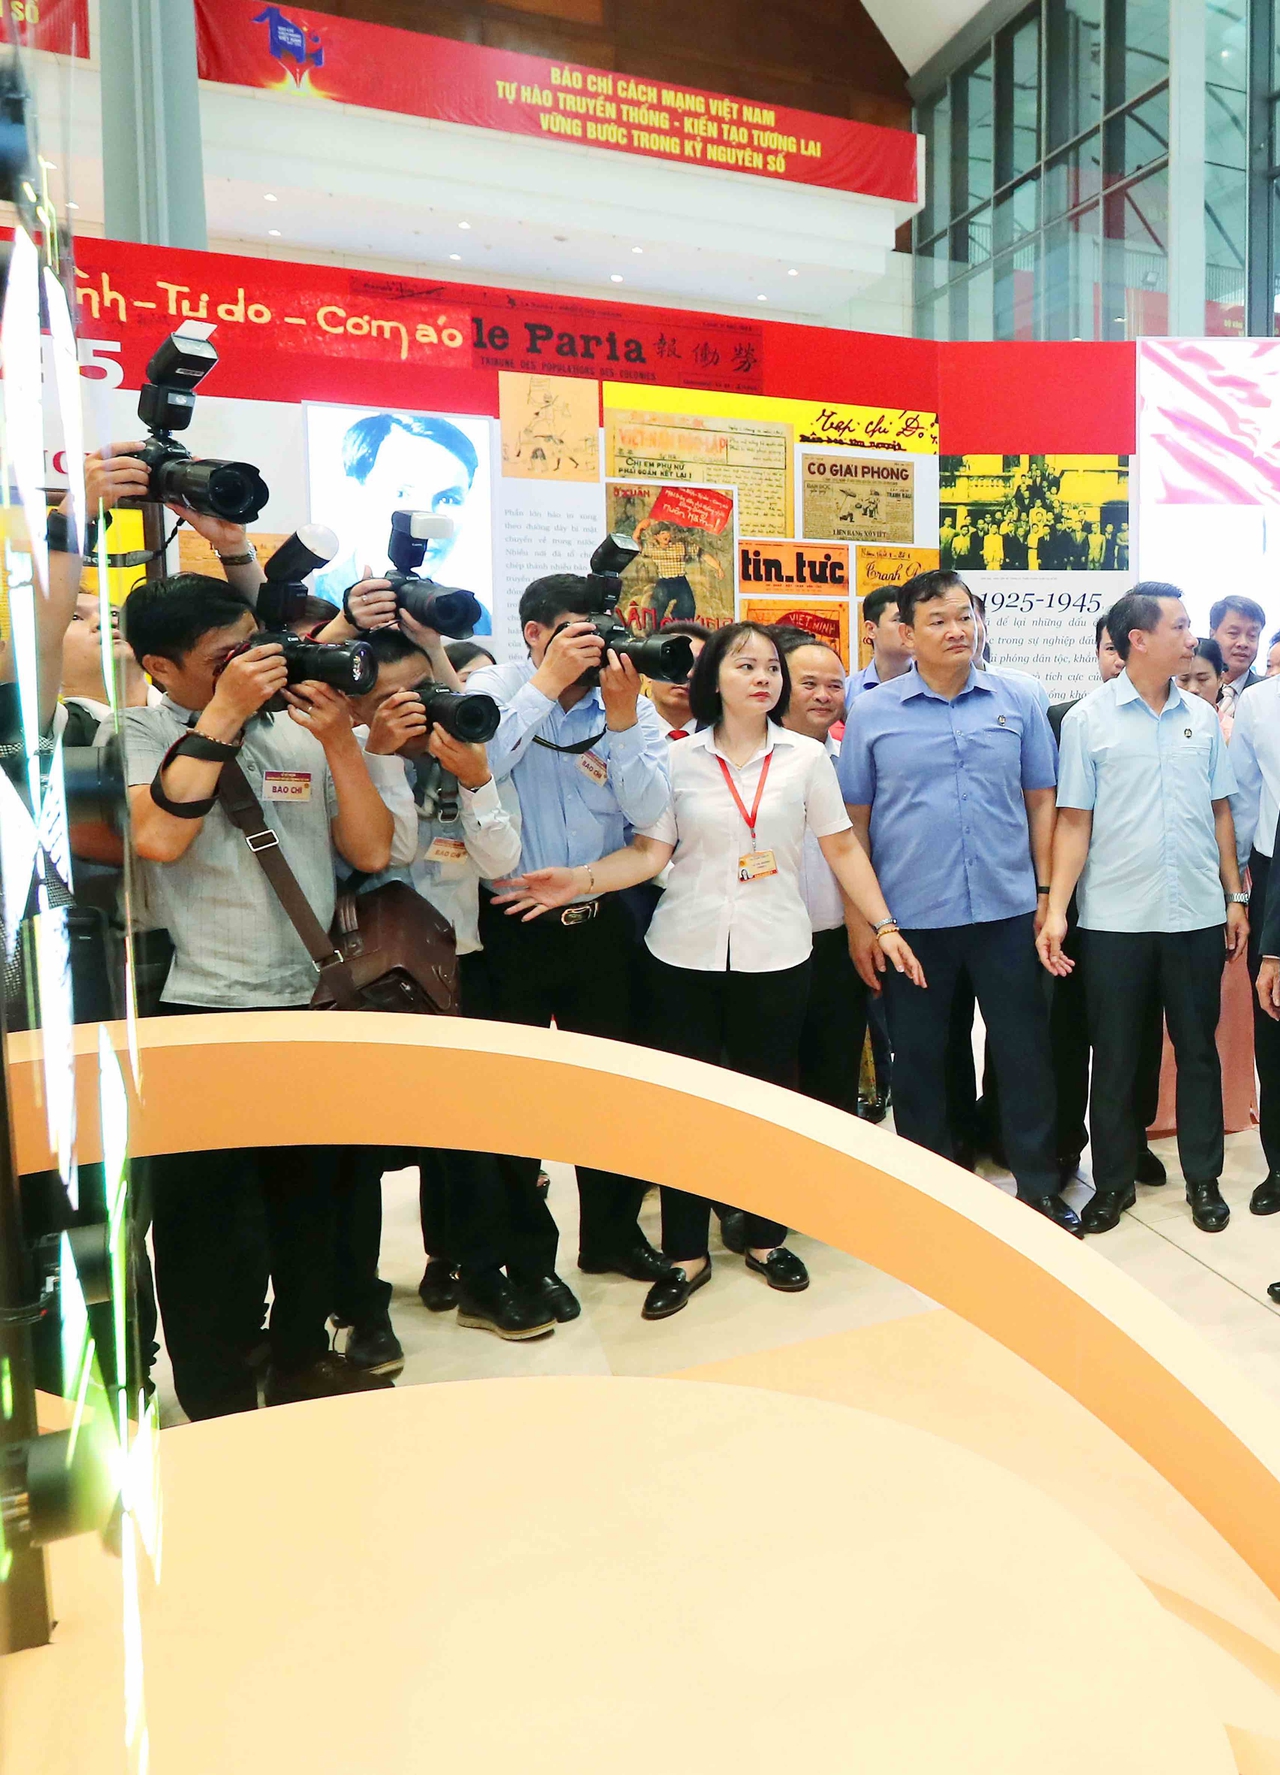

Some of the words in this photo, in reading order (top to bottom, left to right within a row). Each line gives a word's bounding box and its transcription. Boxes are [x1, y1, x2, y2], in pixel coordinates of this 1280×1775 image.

[551, 66, 583, 90] BÁO
[587, 74, 613, 95] CHÍ
[617, 79, 658, 104] CÁCH
[661, 88, 706, 113] MẠNG
[708, 98, 739, 121] VIỆT
[742, 105, 776, 127] NAM
[496, 80, 518, 104] TỰ
[520, 84, 553, 107] HÀO
[557, 92, 617, 119] TRUYỀN
[620, 103, 670, 130] THỐNG
[684, 115, 718, 139] KIẾN
[721, 123, 749, 146] TẠO
[751, 129, 797, 153] TƯƠNG
[800, 139, 822, 158] LAI
[539, 112, 583, 138] VỮNG
[586, 121, 628, 145] BƯỚC
[631, 129, 681, 155] TRONG
[706, 144, 764, 170] NGUYÊN
[766, 151, 787, 173] SỐ
[216, 287, 272, 324] do
[471, 317, 510, 350] le
[524, 322, 647, 364] Paria
[520, 360, 536, 370] DES
[580, 513, 598, 521] xong
[504, 522, 522, 530] theo
[1013, 617, 1026, 629] lại
[1031, 617, 1063, 629] những
[997, 636, 1025, 647] trong
[1027, 636, 1039, 647] sự
[1042, 635, 1075, 647] nghiệp
[999, 653, 1030, 665] phóng
[1032, 653, 1051, 663] dân
[1044, 672, 1063, 682] tích
[1067, 673, 1084, 683] cực
